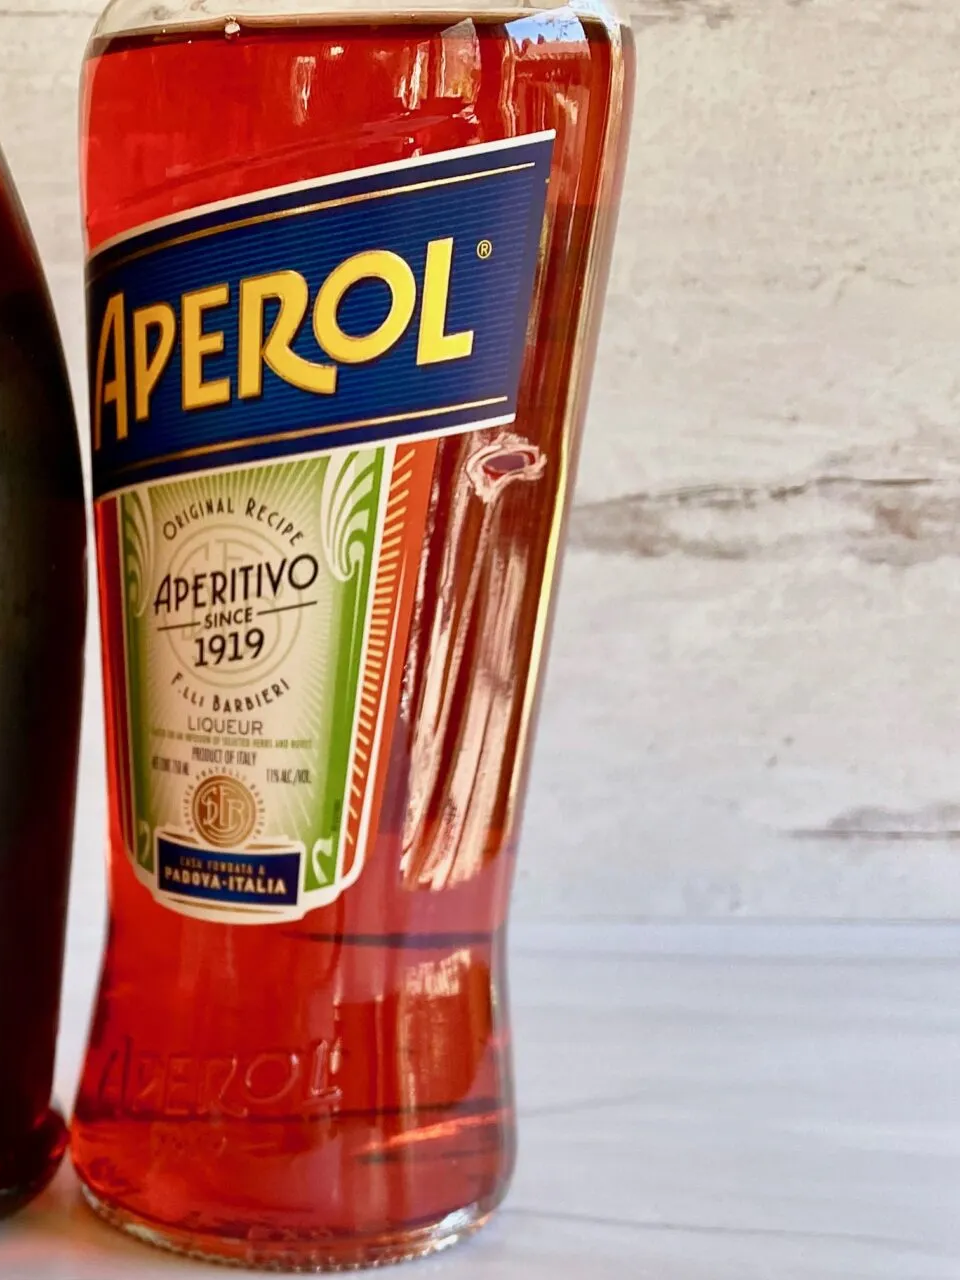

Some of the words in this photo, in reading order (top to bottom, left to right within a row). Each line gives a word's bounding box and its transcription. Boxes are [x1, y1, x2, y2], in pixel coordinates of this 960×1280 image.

[94, 237, 474, 450] APEROL
[162, 497, 235, 541] ORIGINAL
[245, 496, 305, 547] RECIPE
[153, 553, 319, 616] APERITIVO
[203, 607, 253, 630] SINCE
[193, 627, 265, 668] 1919
[212, 677, 291, 713] BARBIERI
[187, 715, 263, 737] LIQUEUR
